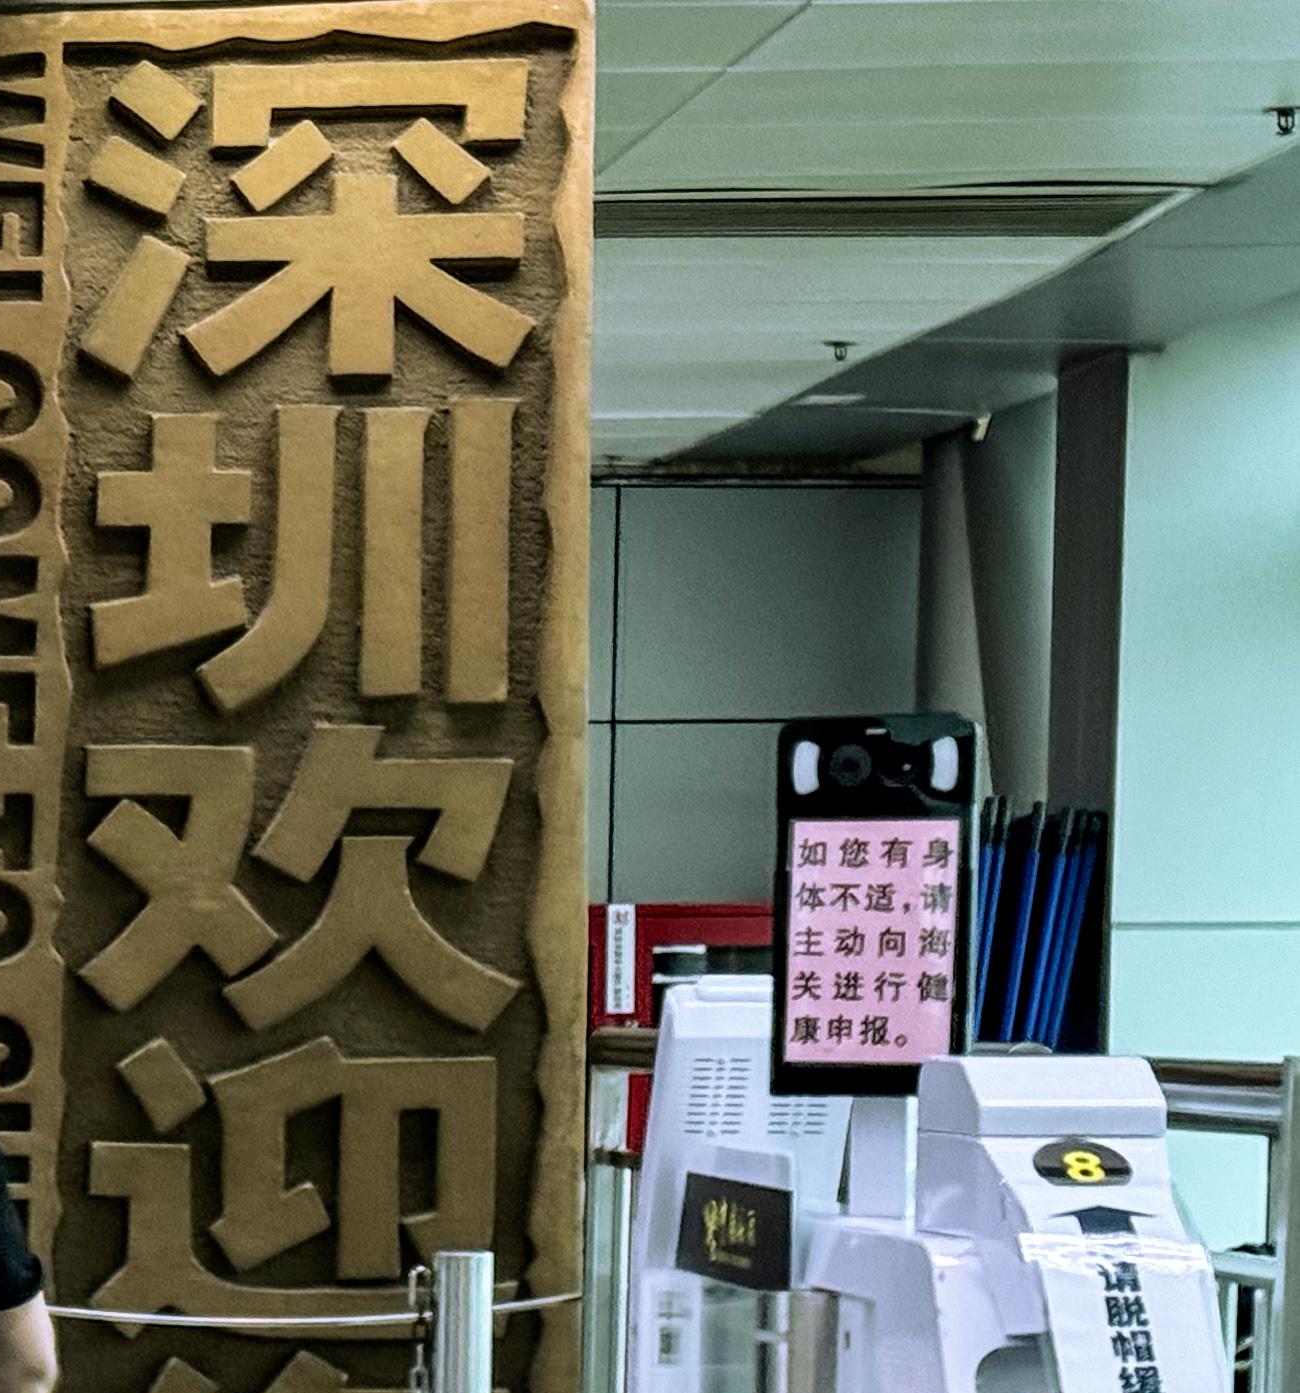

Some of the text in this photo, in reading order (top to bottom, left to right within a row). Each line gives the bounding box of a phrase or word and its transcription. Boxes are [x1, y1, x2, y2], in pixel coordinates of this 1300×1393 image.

[798, 836, 955, 871] 如您有身
[792, 926, 952, 959] 主动向海
[790, 970, 952, 1004] 关进行健
[789, 1014, 910, 1050] 康申报。
[1063, 1150, 1106, 1183] 8
